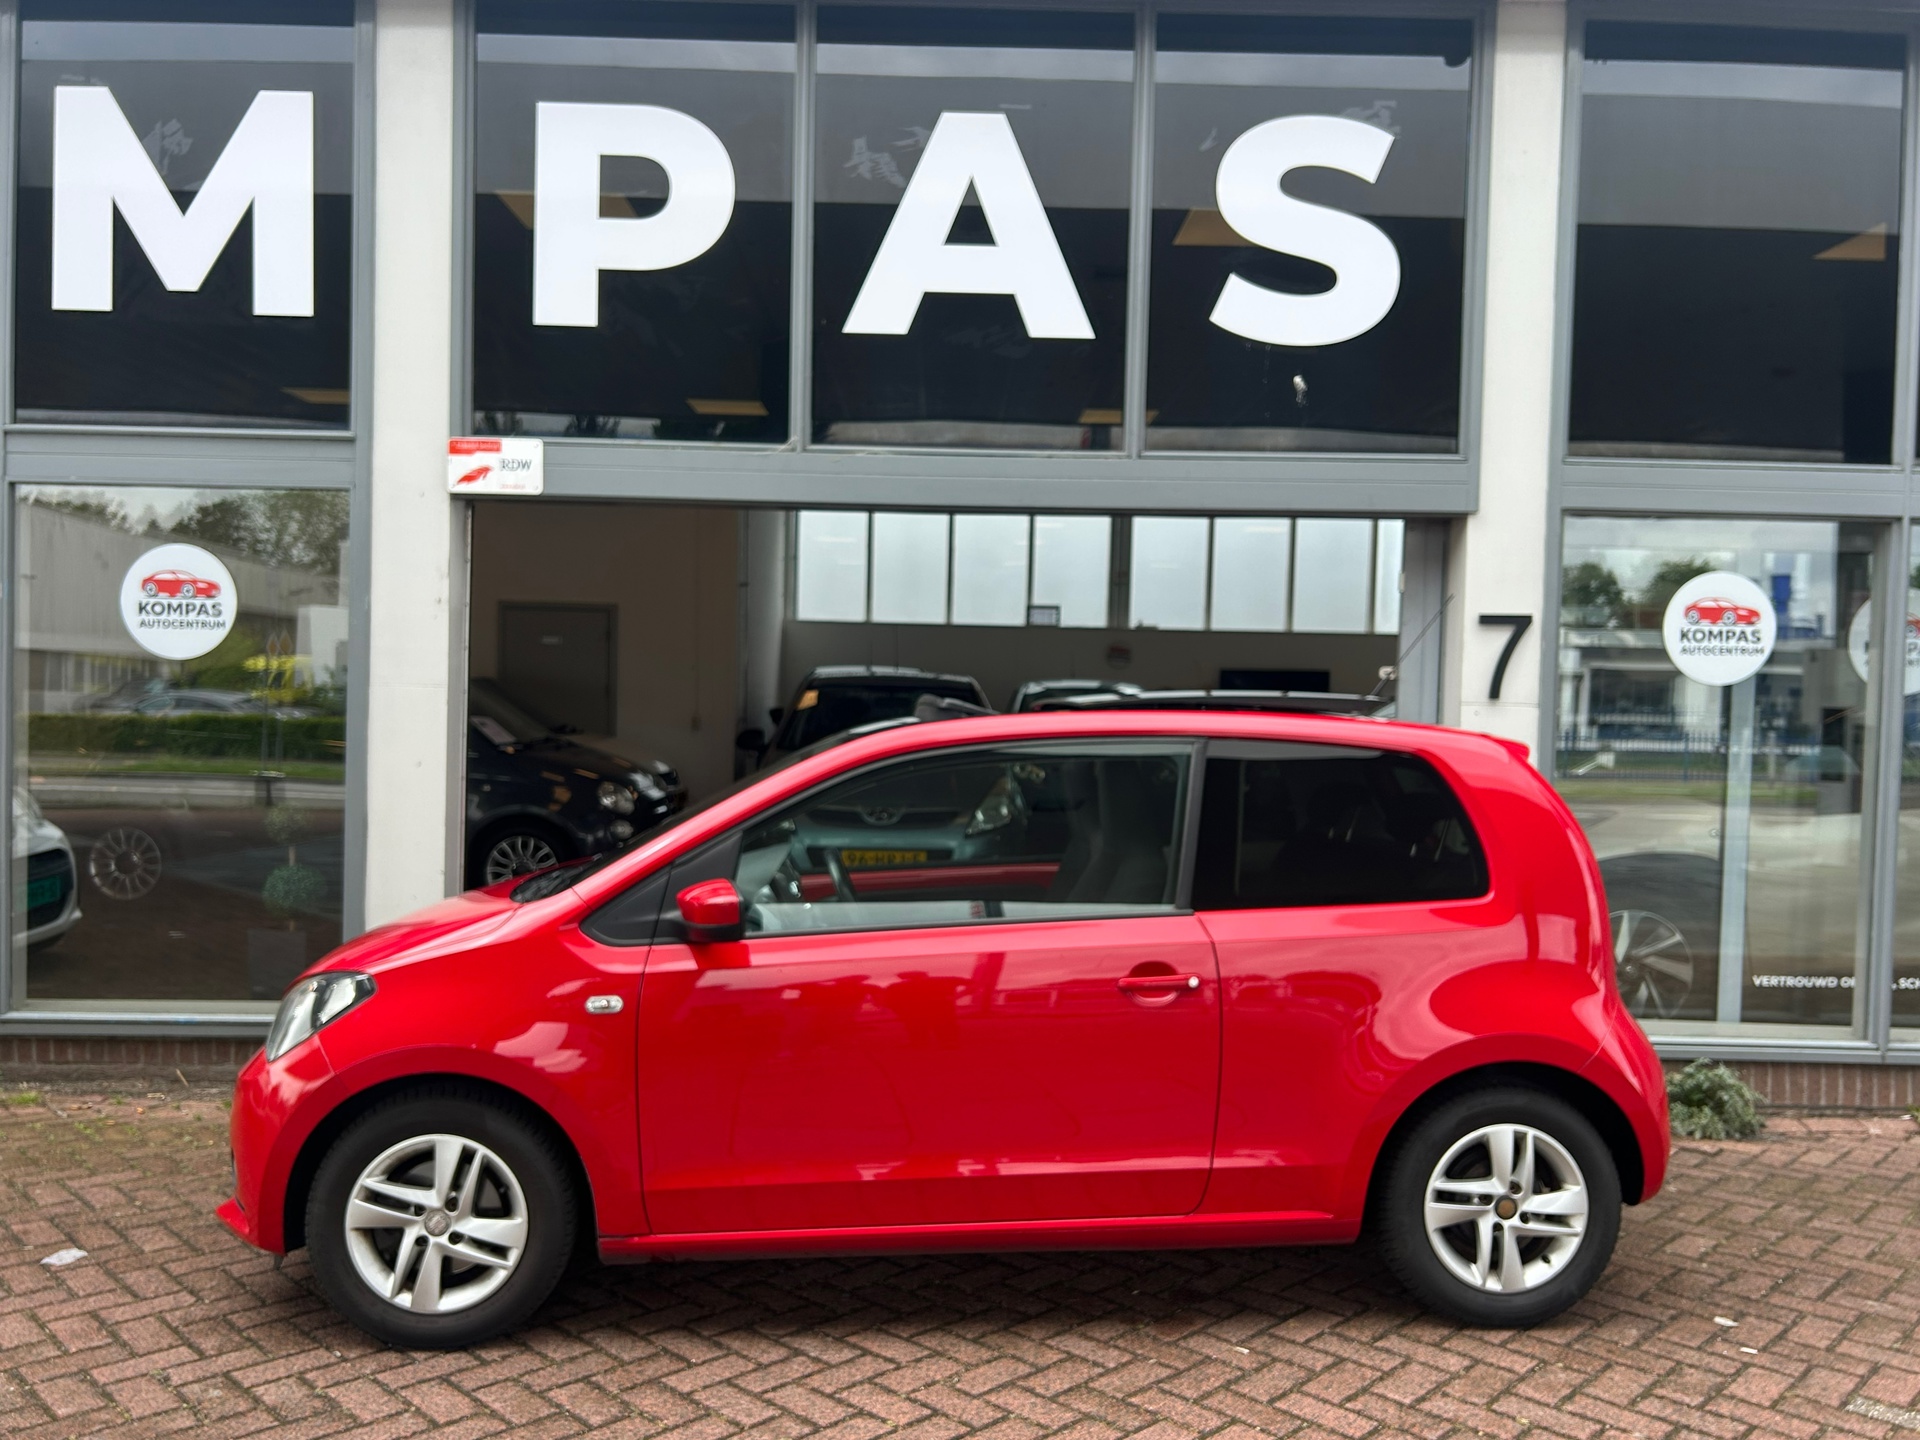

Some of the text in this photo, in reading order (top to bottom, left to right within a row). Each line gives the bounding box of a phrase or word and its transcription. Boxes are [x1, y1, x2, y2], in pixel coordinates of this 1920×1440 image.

[500, 459, 533, 472] RDW
[138, 601, 223, 618] KOMPAS
[139, 618, 227, 630] AUTOCENTRUM
[1680, 627, 1762, 644] KOMPAS
[1479, 614, 1533, 700] 7
[1680, 645, 1765, 657] AUTOCENTRUM
[1752, 974, 1838, 988] VERTROUWD
